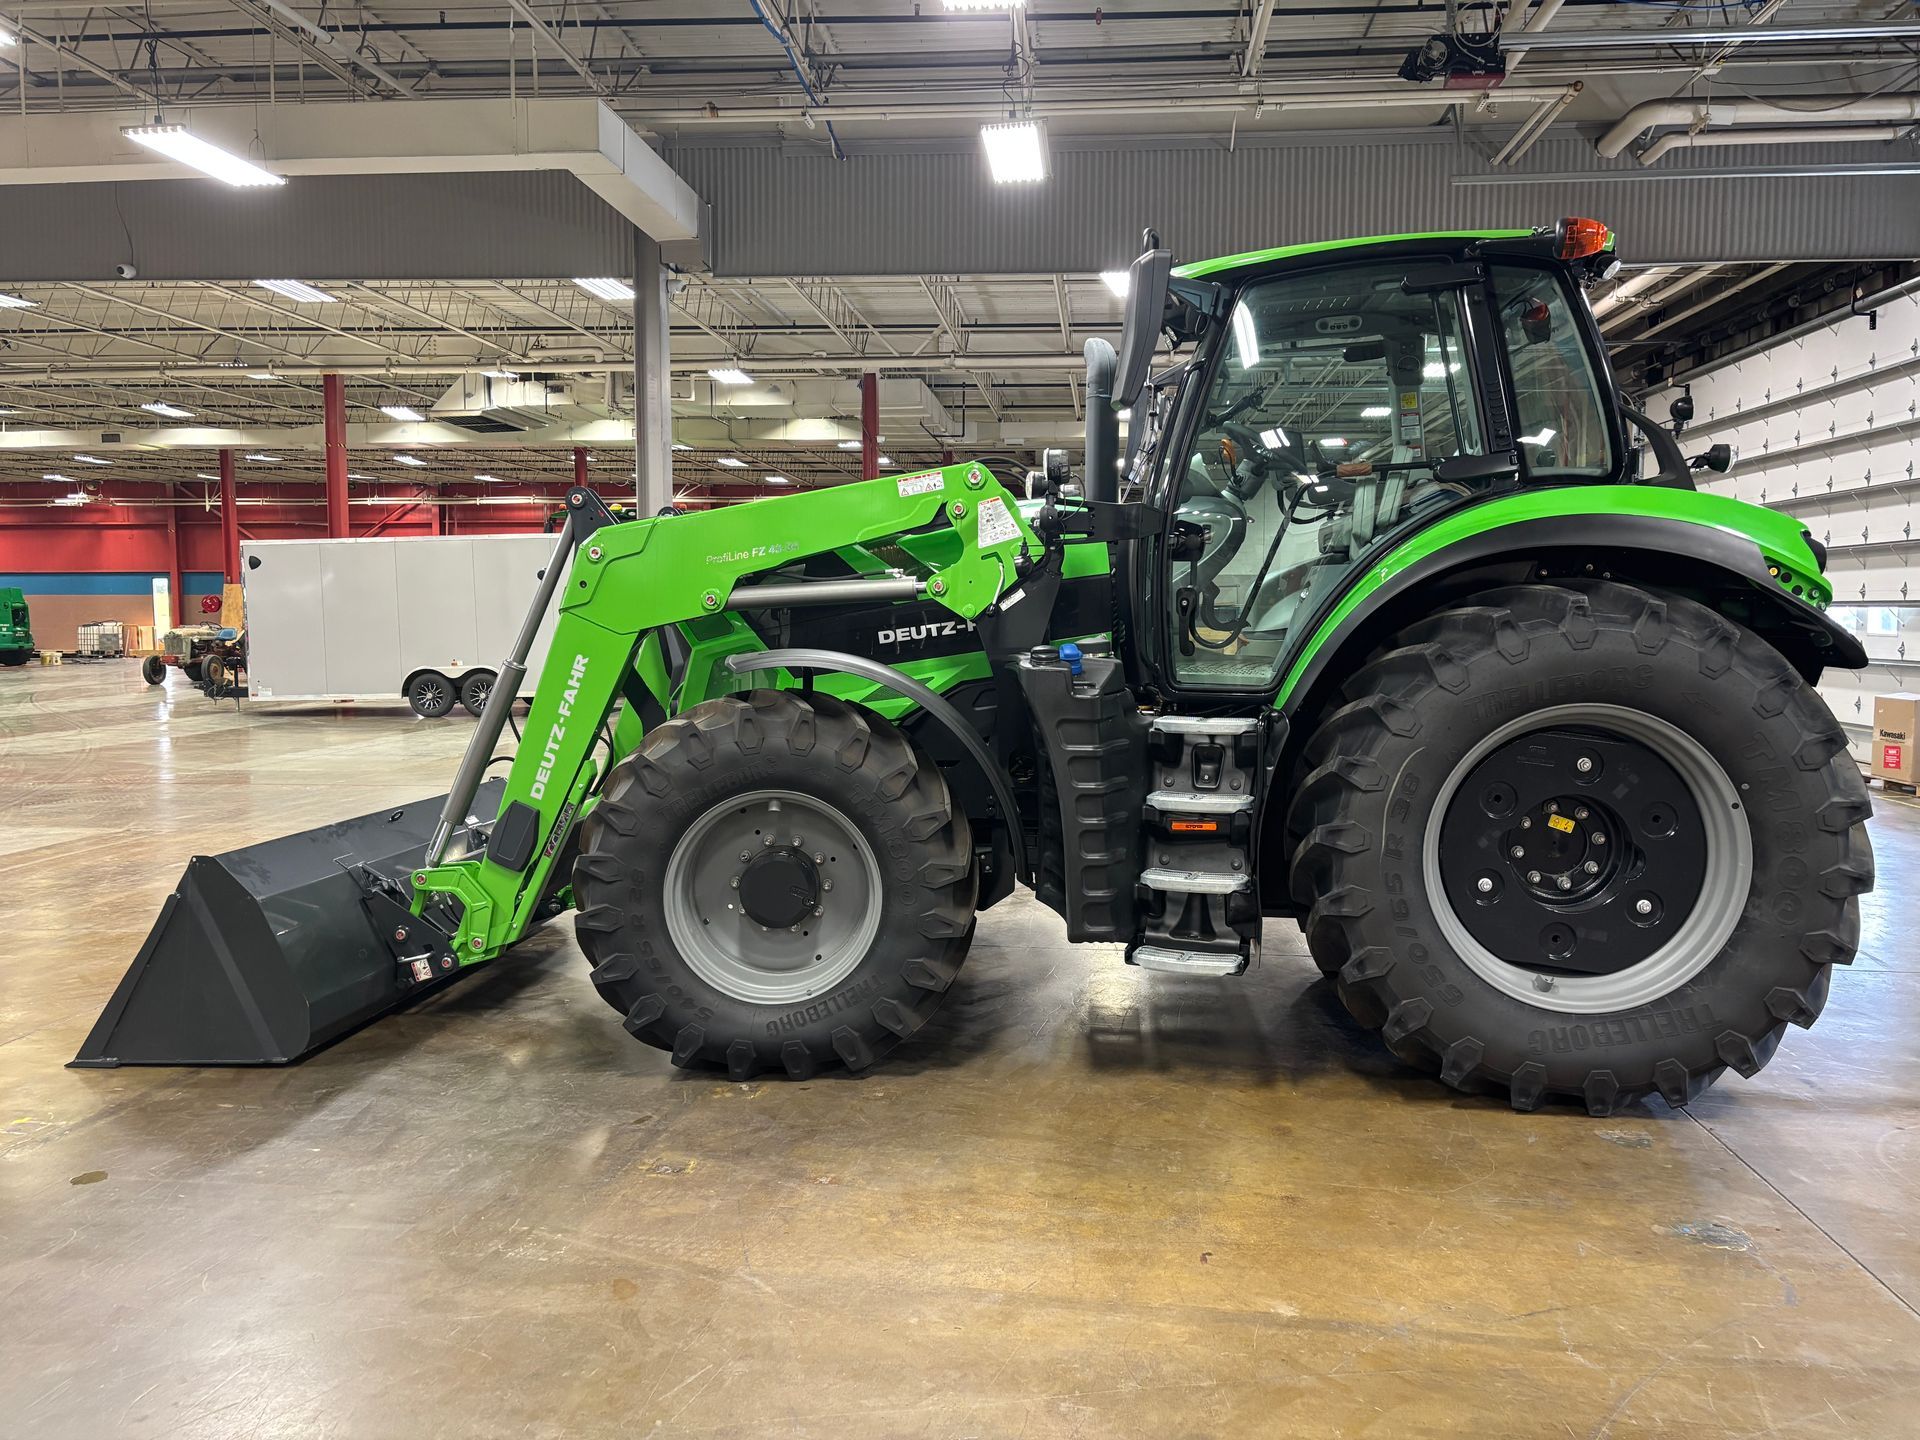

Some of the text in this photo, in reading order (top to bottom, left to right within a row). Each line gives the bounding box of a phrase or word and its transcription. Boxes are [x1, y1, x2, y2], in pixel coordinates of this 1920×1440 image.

[705, 551, 749, 565] ProfiLine
[751, 546, 766, 558] FZ
[1462, 662, 1656, 724] TRELLEBORG
[529, 653, 590, 801] DEUTZ-FAHR
[1879, 728, 1906, 741] Kawasaki
[764, 971, 888, 1038] TRELLEBORG
[1527, 1001, 1727, 1056] TRELLEBORG
